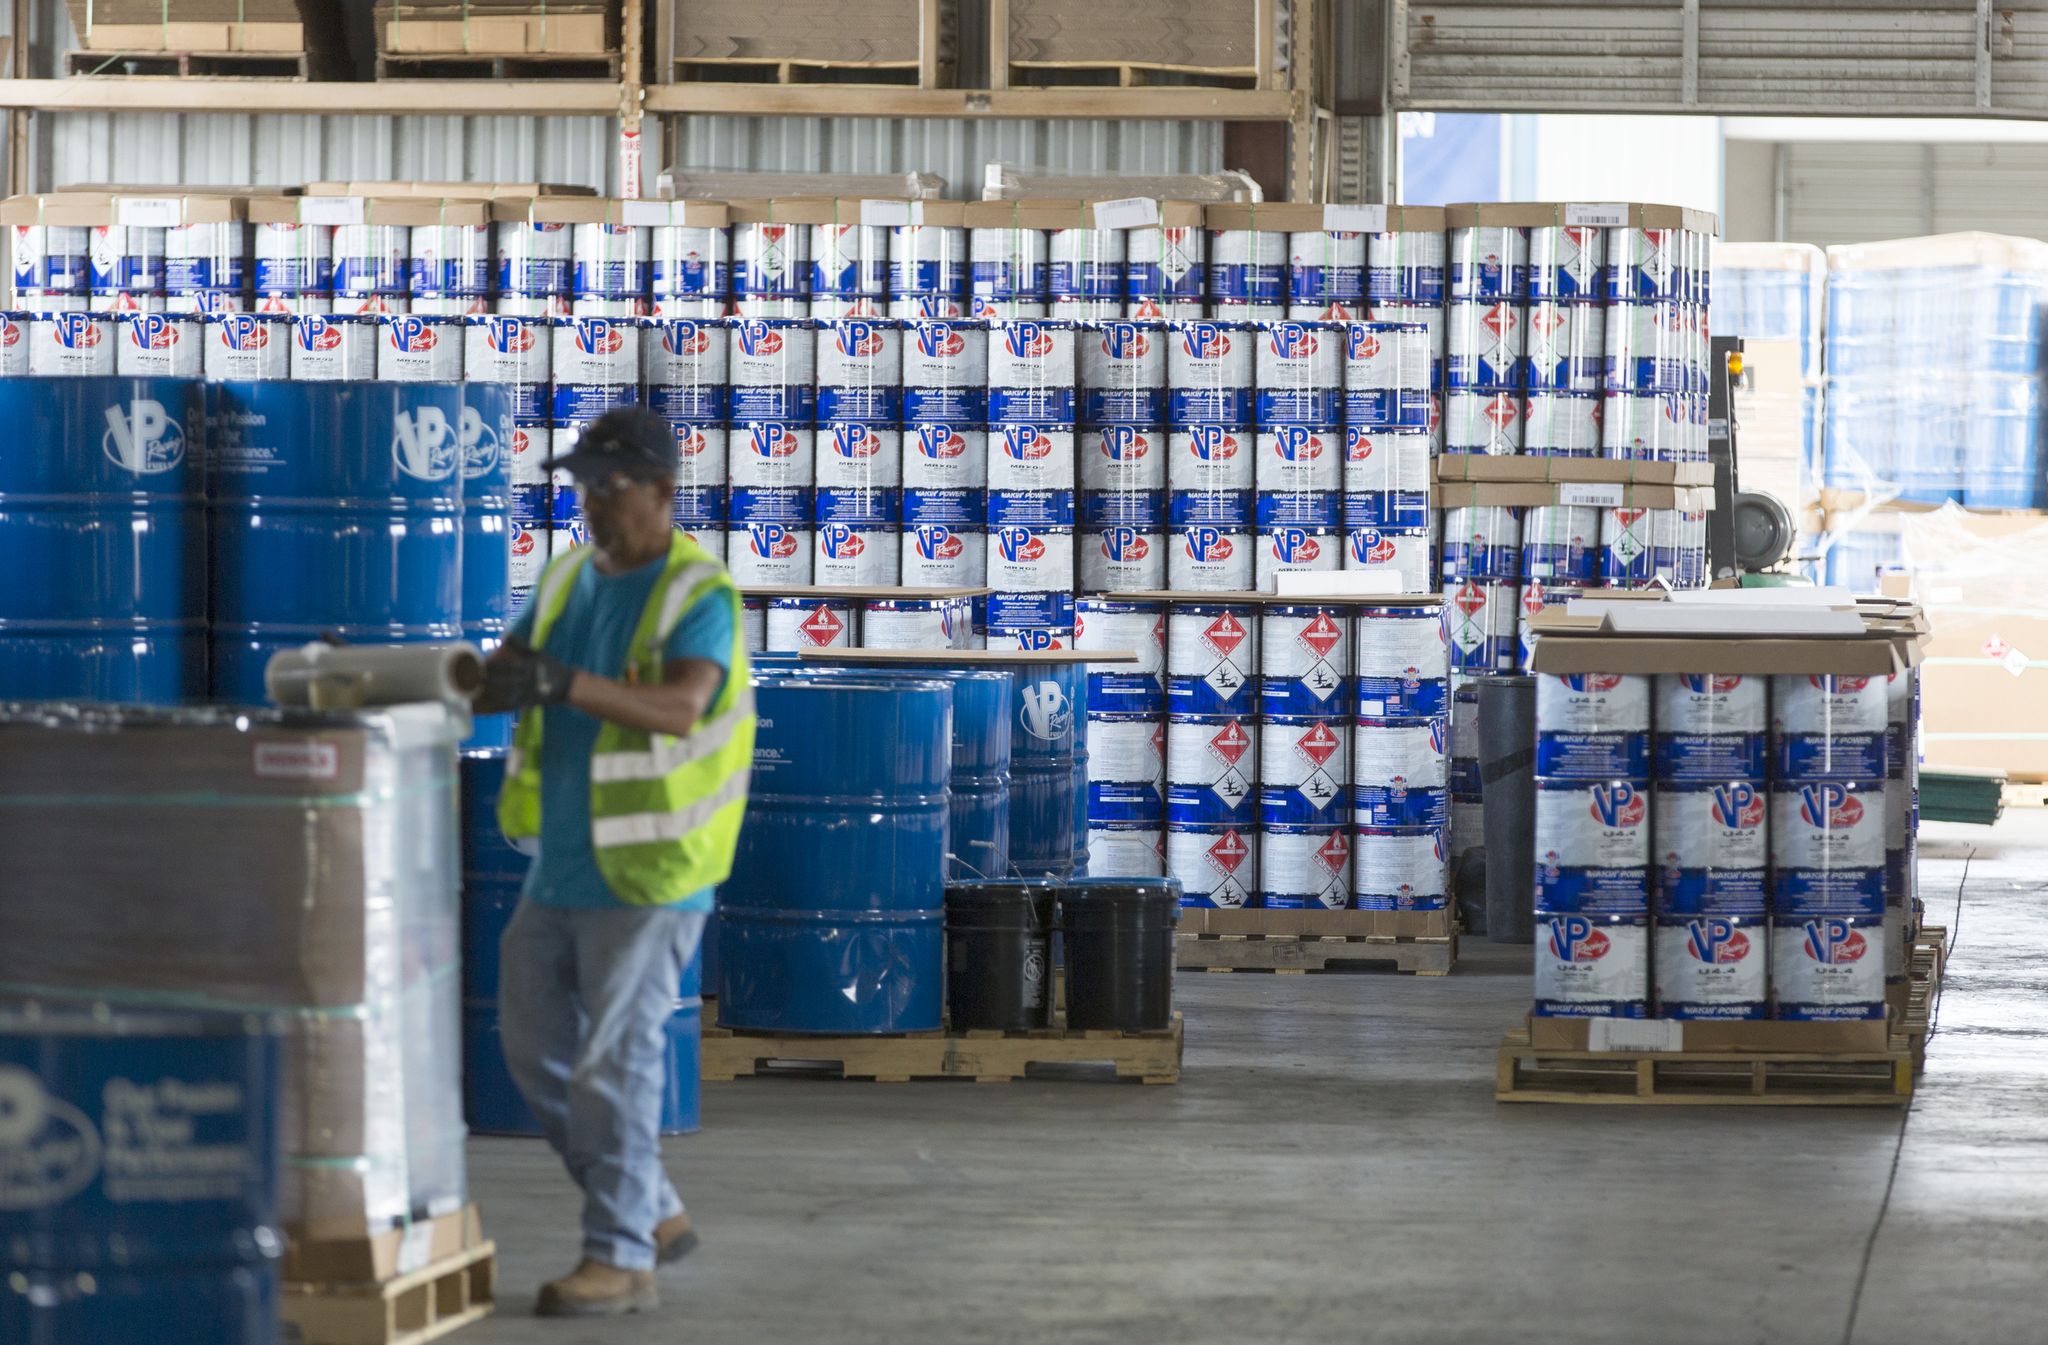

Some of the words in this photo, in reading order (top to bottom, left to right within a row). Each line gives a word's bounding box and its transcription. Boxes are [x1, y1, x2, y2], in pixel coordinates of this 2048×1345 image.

[55, 314, 88, 350] VP
[131, 315, 164, 351] VP
[222, 316, 255, 352] VP
[295, 316, 328, 352] VP
[390, 318, 423, 354] VP
[488, 318, 521, 354] VP
[576, 320, 609, 356] VP
[663, 321, 696, 357] VP
[736, 321, 769, 357] VP
[837, 322, 870, 358] VP
[917, 323, 950, 359] VP
[1006, 323, 1039, 359] VP
[1103, 324, 1136, 360] VP
[1183, 324, 1216, 360] VP
[1271, 324, 1304, 360] VP
[105, 399, 167, 470] VP
[395, 406, 446, 475] VP
[751, 422, 784, 458] VP
[833, 423, 866, 459] VP
[918, 424, 951, 460] VP
[1004, 425, 1037, 461] VP
[1102, 425, 1135, 461] VP
[1191, 425, 1224, 461] VP
[1276, 426, 1309, 462] VP
[751, 524, 784, 560] VP
[818, 524, 851, 560] VP
[916, 525, 949, 561] VP
[998, 527, 1031, 563] VP
[1102, 527, 1135, 563] VP
[1186, 527, 1219, 563] VP
[1273, 528, 1306, 564] VP
[1349, 529, 1382, 565] VP
[1022, 681, 1062, 736] VP
[1590, 781, 1633, 827] VP
[1711, 783, 1755, 828] VP
[1801, 782, 1848, 829] VP
[1550, 916, 1592, 962] VP
[1688, 917, 1734, 963] VP
[1805, 917, 1851, 964] VP
